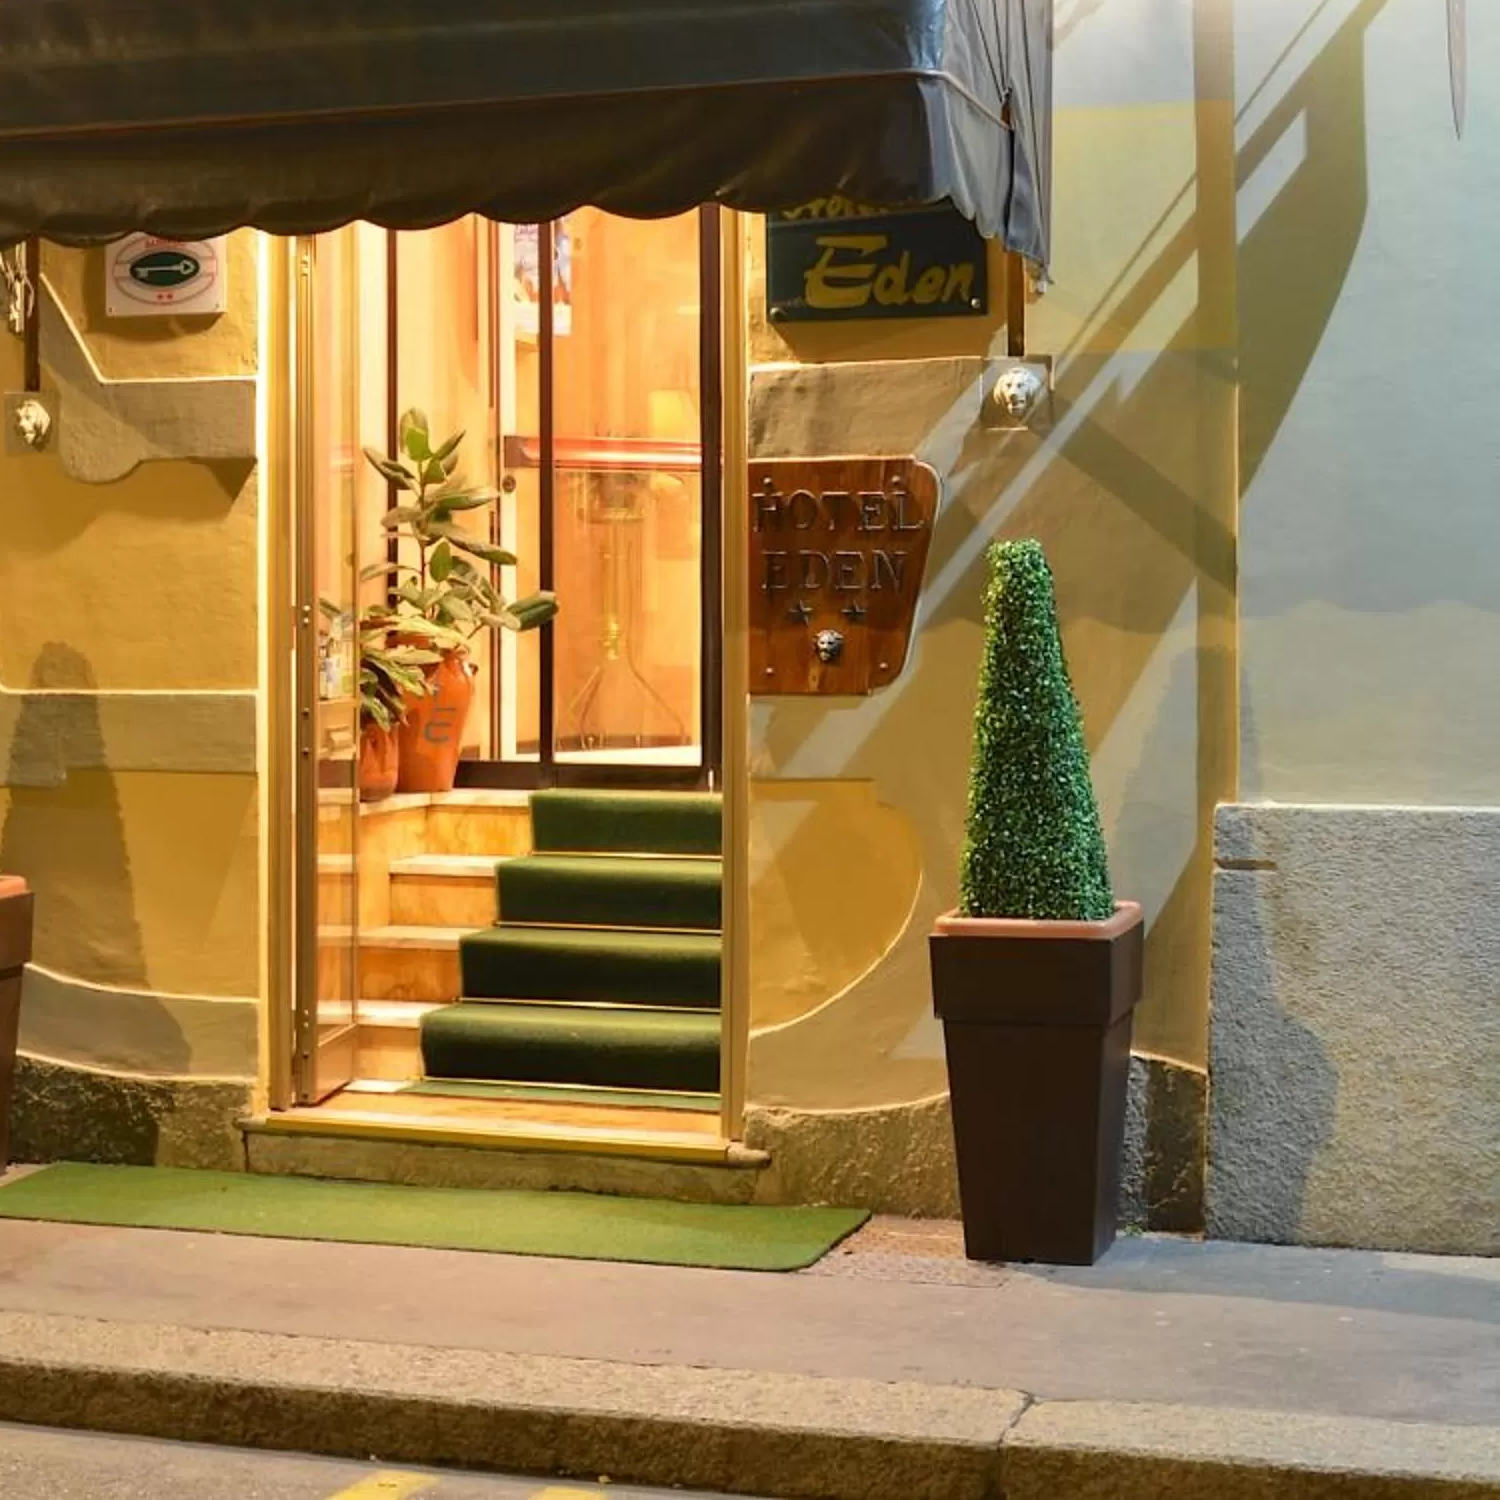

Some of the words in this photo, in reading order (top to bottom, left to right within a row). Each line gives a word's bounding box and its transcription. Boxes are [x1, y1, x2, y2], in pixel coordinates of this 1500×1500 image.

[803, 235, 975, 309] Eden
[751, 488, 925, 533] HOTEL
[761, 549, 909, 591] EDEN
